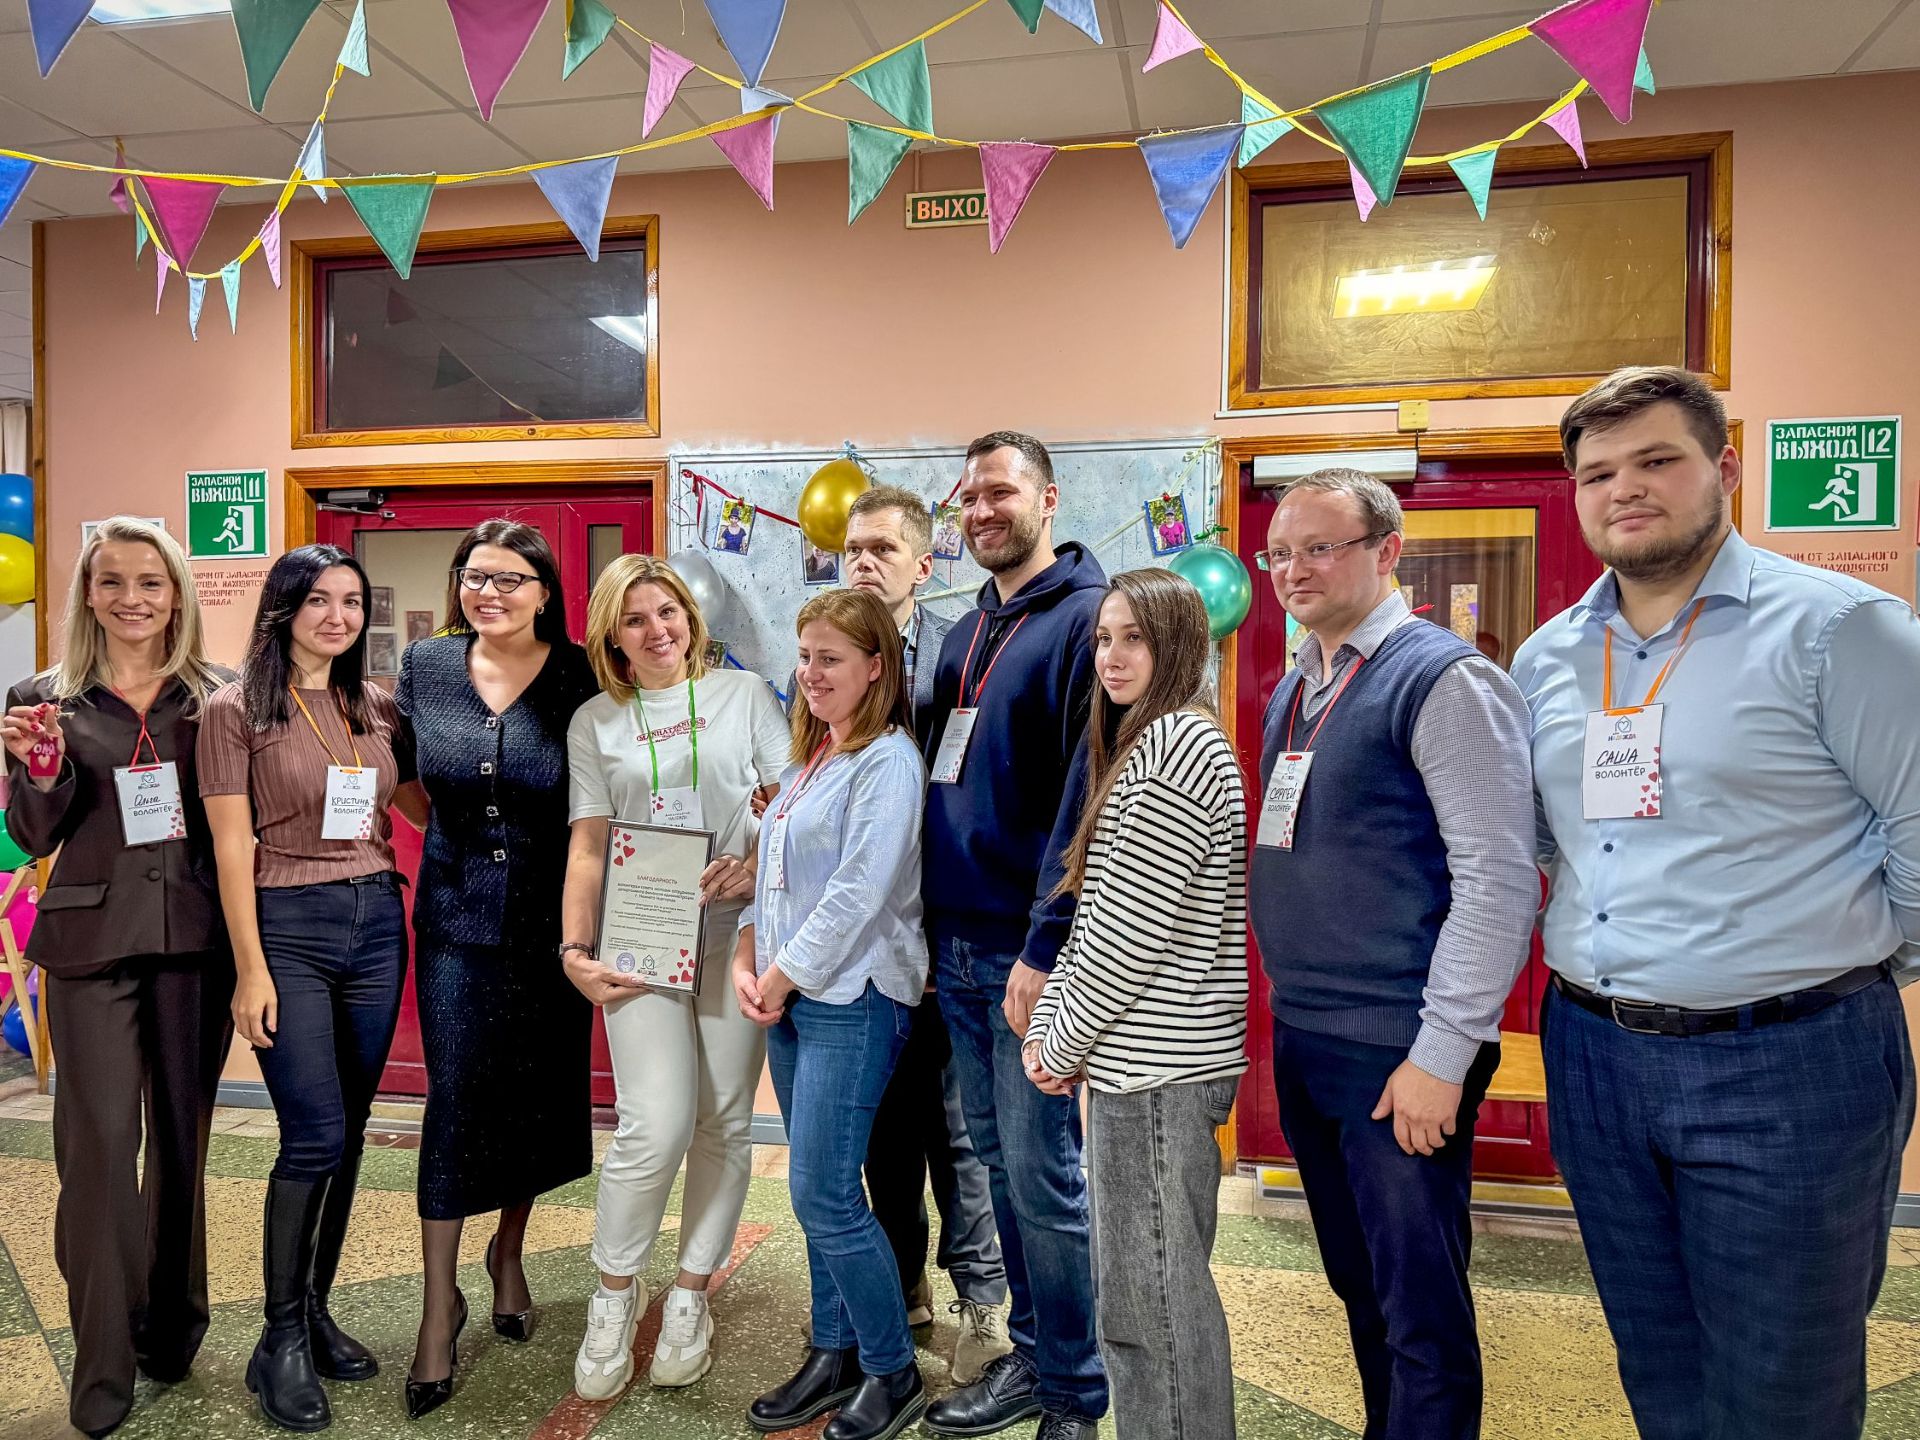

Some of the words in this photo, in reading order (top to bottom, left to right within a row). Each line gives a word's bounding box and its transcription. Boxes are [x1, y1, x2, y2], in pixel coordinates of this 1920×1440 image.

[1775, 422, 1857, 439] ЗАПАСНОЙ
[1867, 427, 1892, 453] 12
[1775, 439, 1860, 460] ВЫХОД
[191, 474, 242, 487] ЗАПАСНОЙ
[248, 477, 260, 498] 11
[191, 487, 243, 503] ВЫХОД
[1807, 553, 1822, 561] ОТ
[1827, 551, 1898, 561] ЗАПАСНОГО
[193, 572, 213, 580] ЛЮЧИ
[1596, 748, 1639, 767] САША
[1595, 766, 1646, 779] ВОЛОНТЁР
[133, 805, 173, 817] ВОЛОНТЁР
[333, 807, 367, 815] ВОЛОНТЁР
